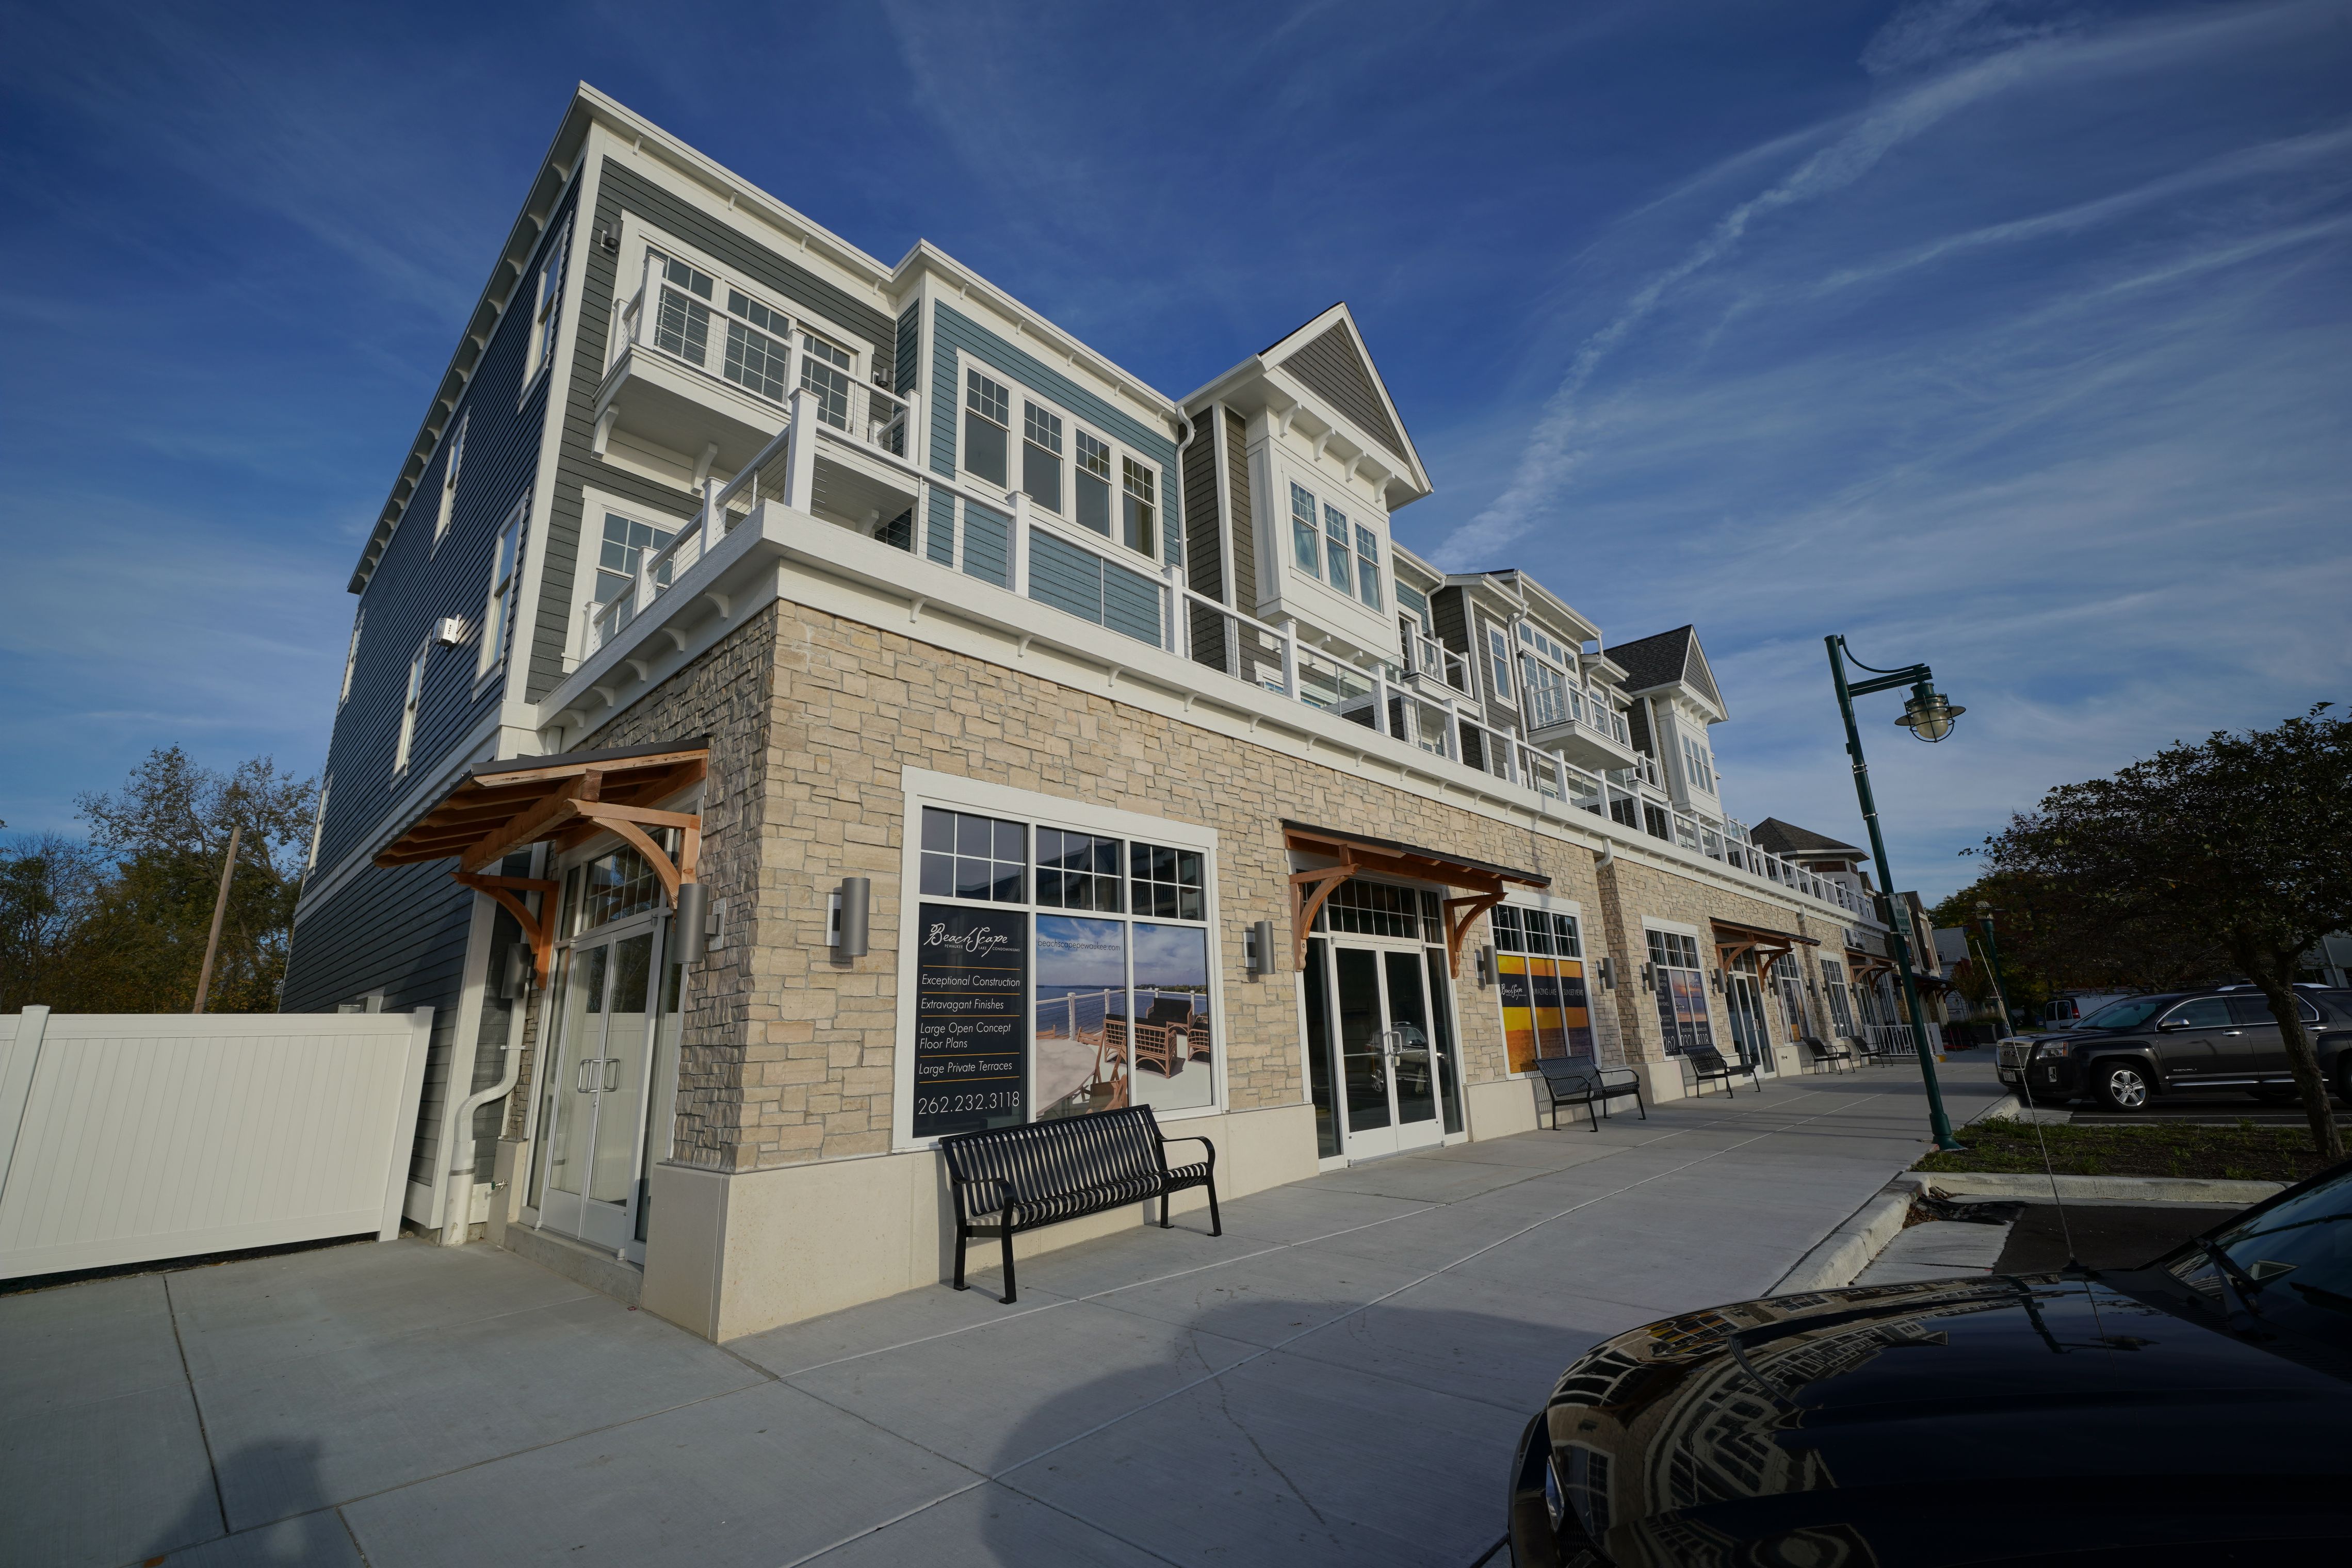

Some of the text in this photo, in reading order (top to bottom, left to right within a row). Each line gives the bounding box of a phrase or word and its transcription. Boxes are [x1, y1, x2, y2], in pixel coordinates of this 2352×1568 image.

[1896, 909, 1906, 917] HOUR
[1037, 937, 1121, 951] beachscapepewaukee.com
[921, 974, 1020, 988] Exceptional Construction
[921, 998, 1004, 1012] Extravagant Finishes
[920, 1022, 1011, 1037] Large Open Concept
[920, 1037, 968, 1049] Floor Plans
[919, 1060, 1012, 1077] Large Private Terraces
[918, 1091, 1020, 1115] 262.232.3118
